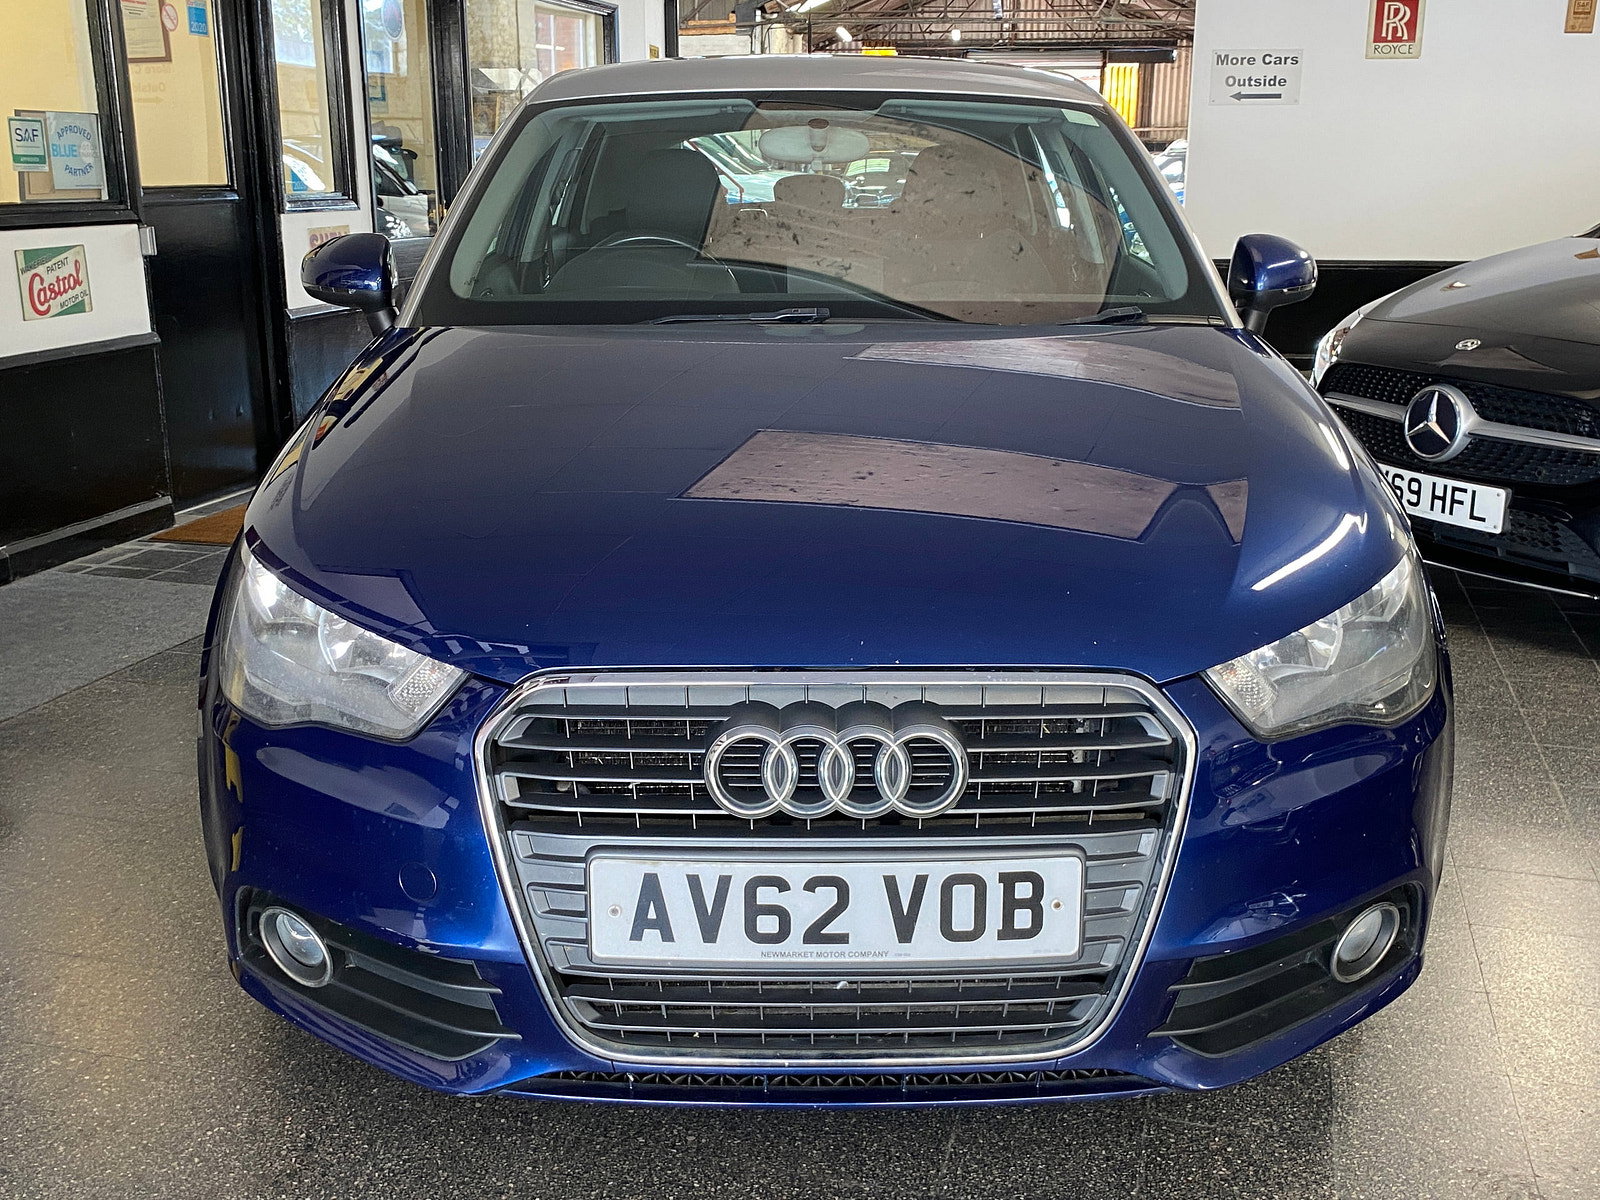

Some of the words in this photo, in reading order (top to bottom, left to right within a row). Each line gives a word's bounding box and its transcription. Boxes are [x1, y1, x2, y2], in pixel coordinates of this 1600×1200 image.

[191, 21, 207, 33] 2020
[1373, 44, 1414, 55] ROYCE
[1215, 53, 1257, 66] More
[1262, 53, 1299, 66] Cars
[1225, 75, 1288, 88] Outside
[15, 127, 39, 142] SAF
[56, 125, 92, 141] APPROVED
[51, 143, 78, 158] BLUE
[64, 162, 94, 177] PARTNER
[46, 256, 69, 275] PATENT
[28, 259, 83, 316] Castrol
[59, 294, 80, 310] MOTOR
[79, 289, 89, 299] OIL
[1384, 470, 1422, 507] 69
[1430, 481, 1486, 523] HFL
[628, 872, 851, 945] AV62
[881, 870, 1046, 944] VOB
[760, 951, 814, 959] NEWMARKET
[815, 951, 846, 959] MOTOR
[848, 950, 889, 959] COMPANY
